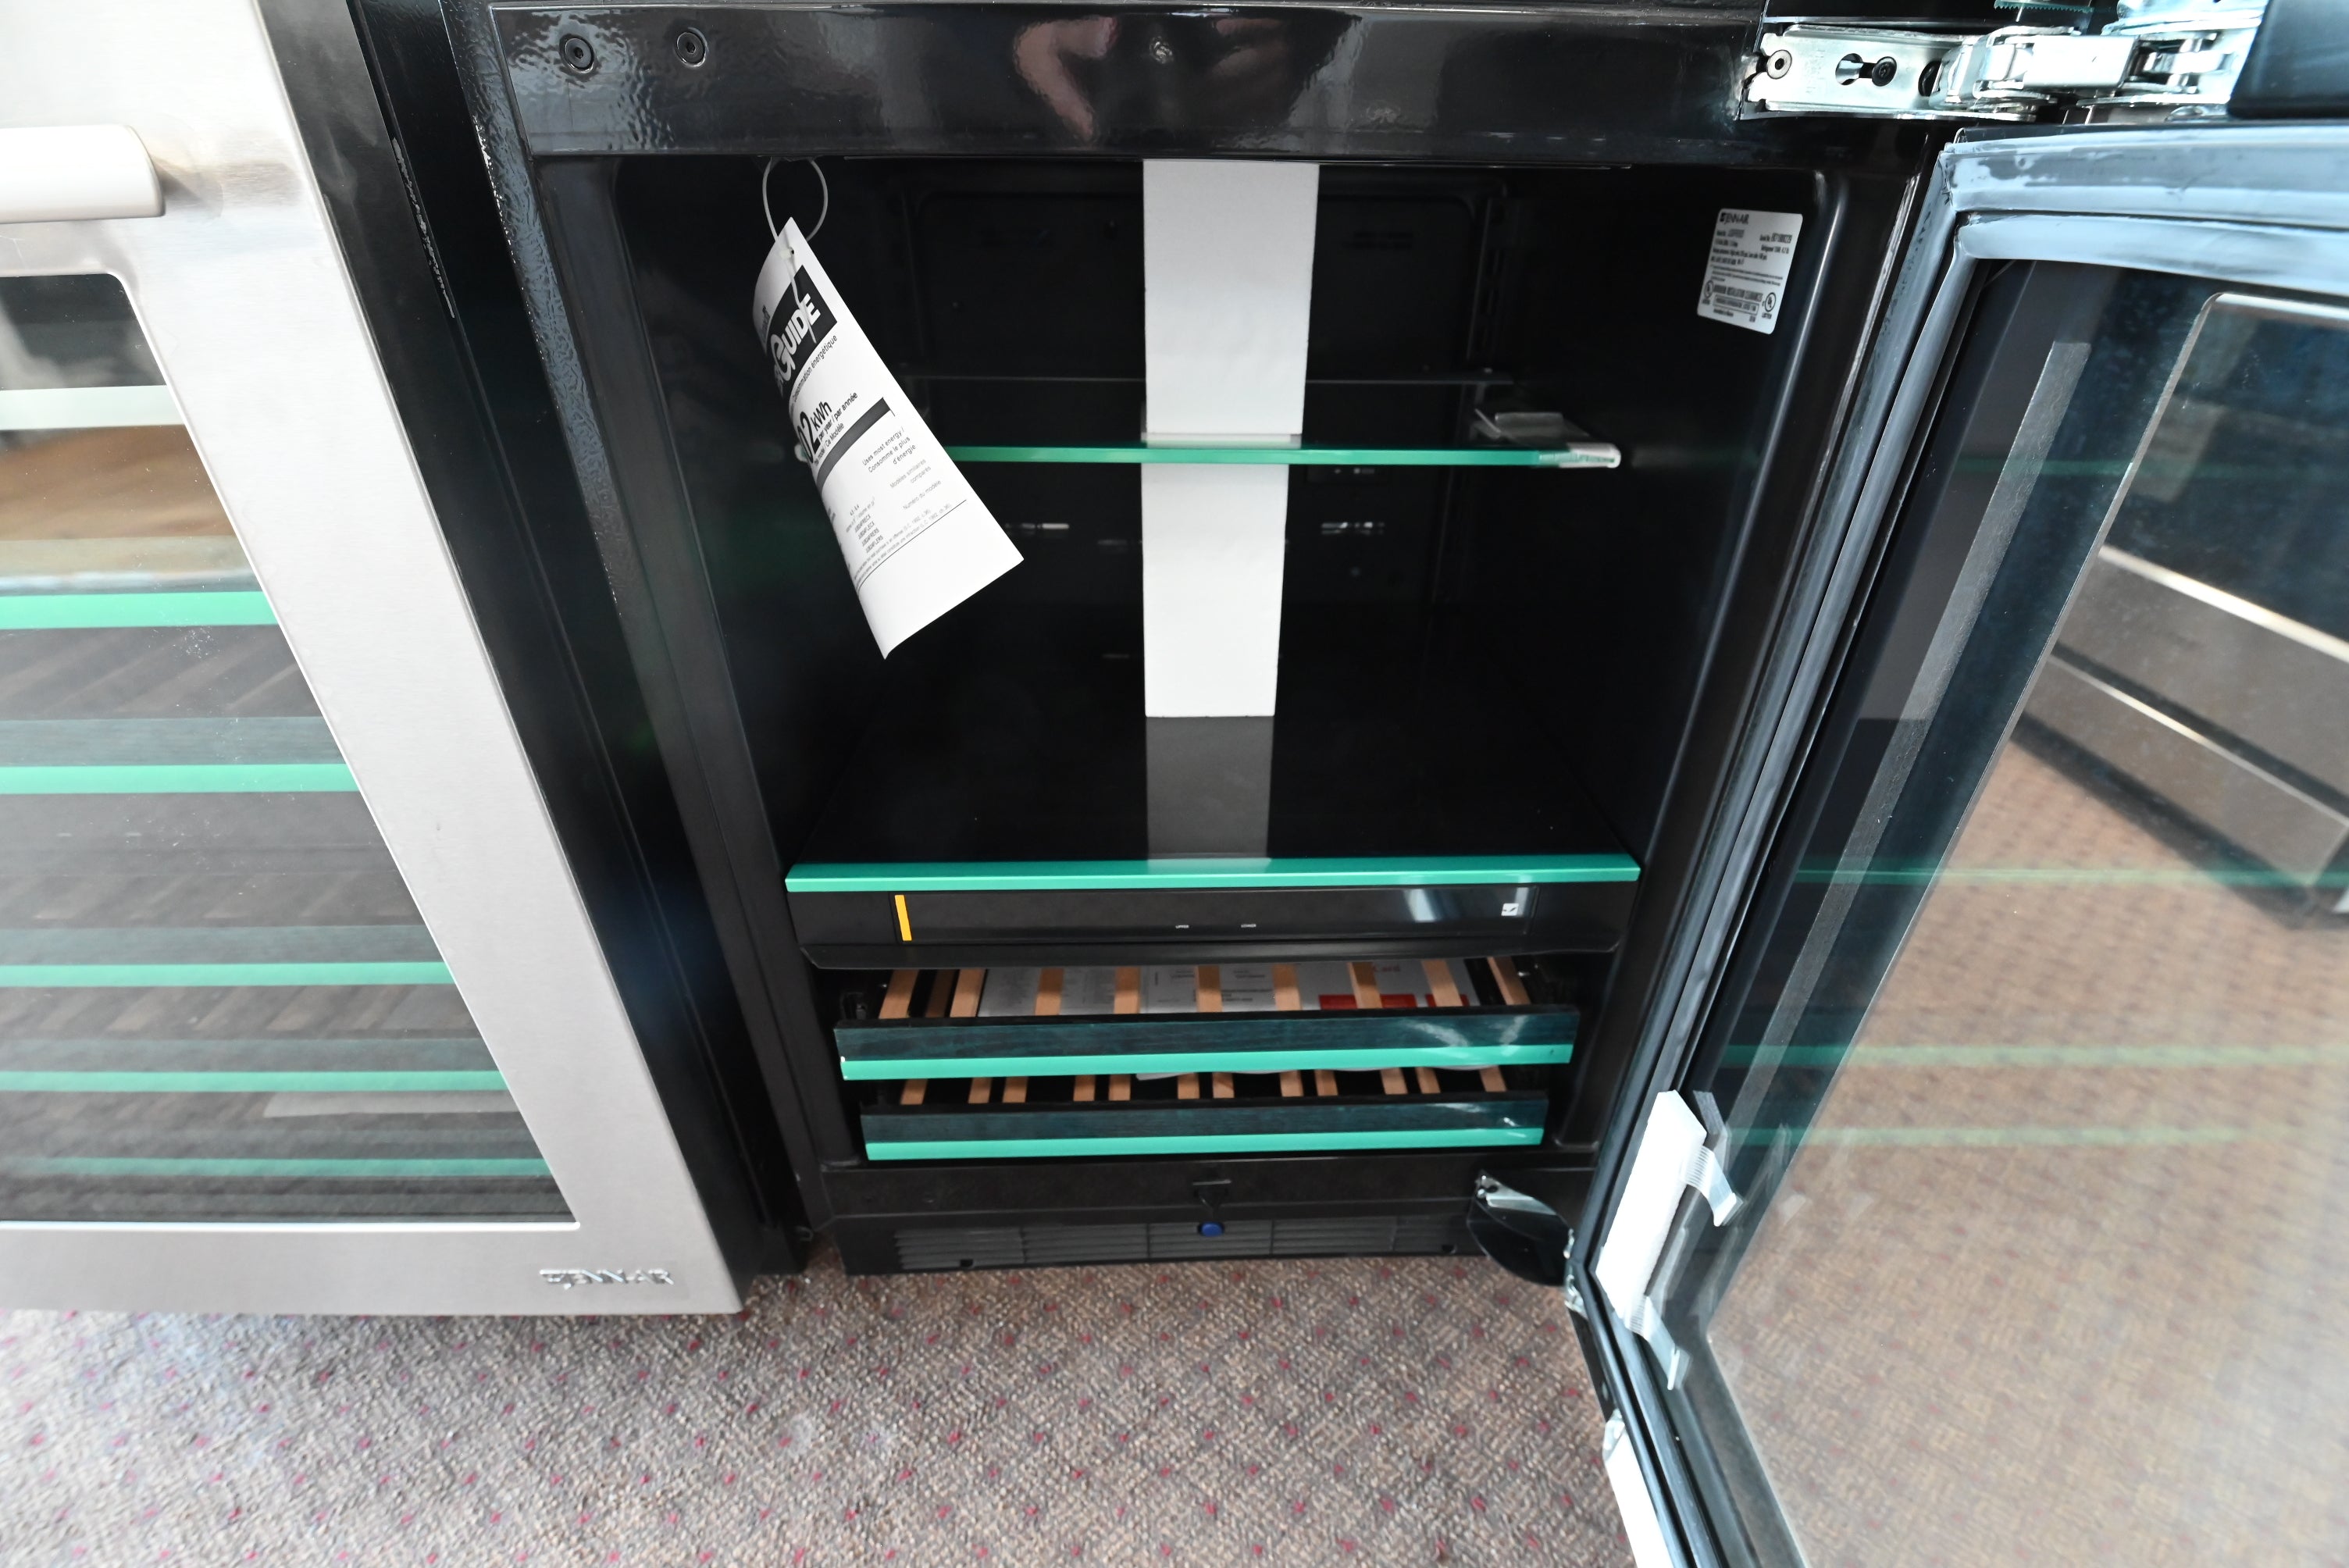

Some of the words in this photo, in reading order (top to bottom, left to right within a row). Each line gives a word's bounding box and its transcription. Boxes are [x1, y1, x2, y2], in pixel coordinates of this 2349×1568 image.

[771, 293, 821, 384] GUIDE
[811, 334, 838, 369] énergétique
[810, 401, 832, 432] kWh
[833, 408, 843, 422] par
[841, 392, 858, 412] année
[862, 454, 874, 466] Uses
[873, 444, 886, 456] most
[885, 430, 902, 446] energy
[868, 450, 893, 473] Consomme
[898, 437, 911, 449] plus
